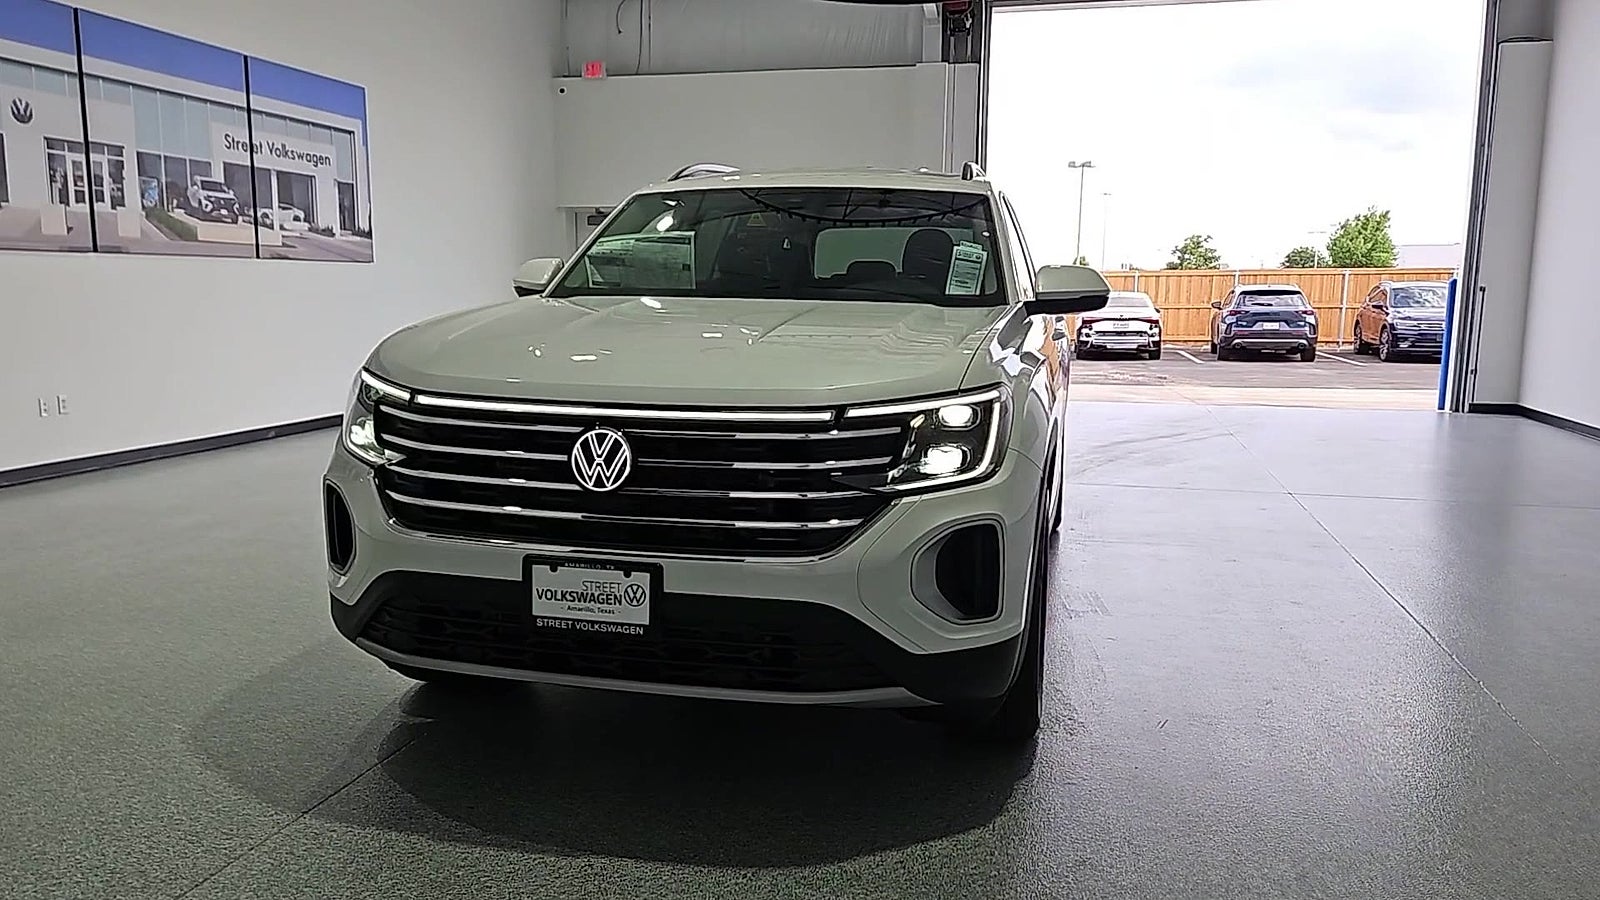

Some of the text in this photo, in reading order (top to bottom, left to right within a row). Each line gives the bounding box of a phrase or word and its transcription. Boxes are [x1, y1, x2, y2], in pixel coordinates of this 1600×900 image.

[267, 141, 332, 167] Volkswagen
[582, 580, 622, 593] STREET
[536, 588, 623, 606] VOLKSWAGEN
[597, 607, 615, 615] Texas
[536, 618, 644, 635] STREET VOLKSWAGEN
